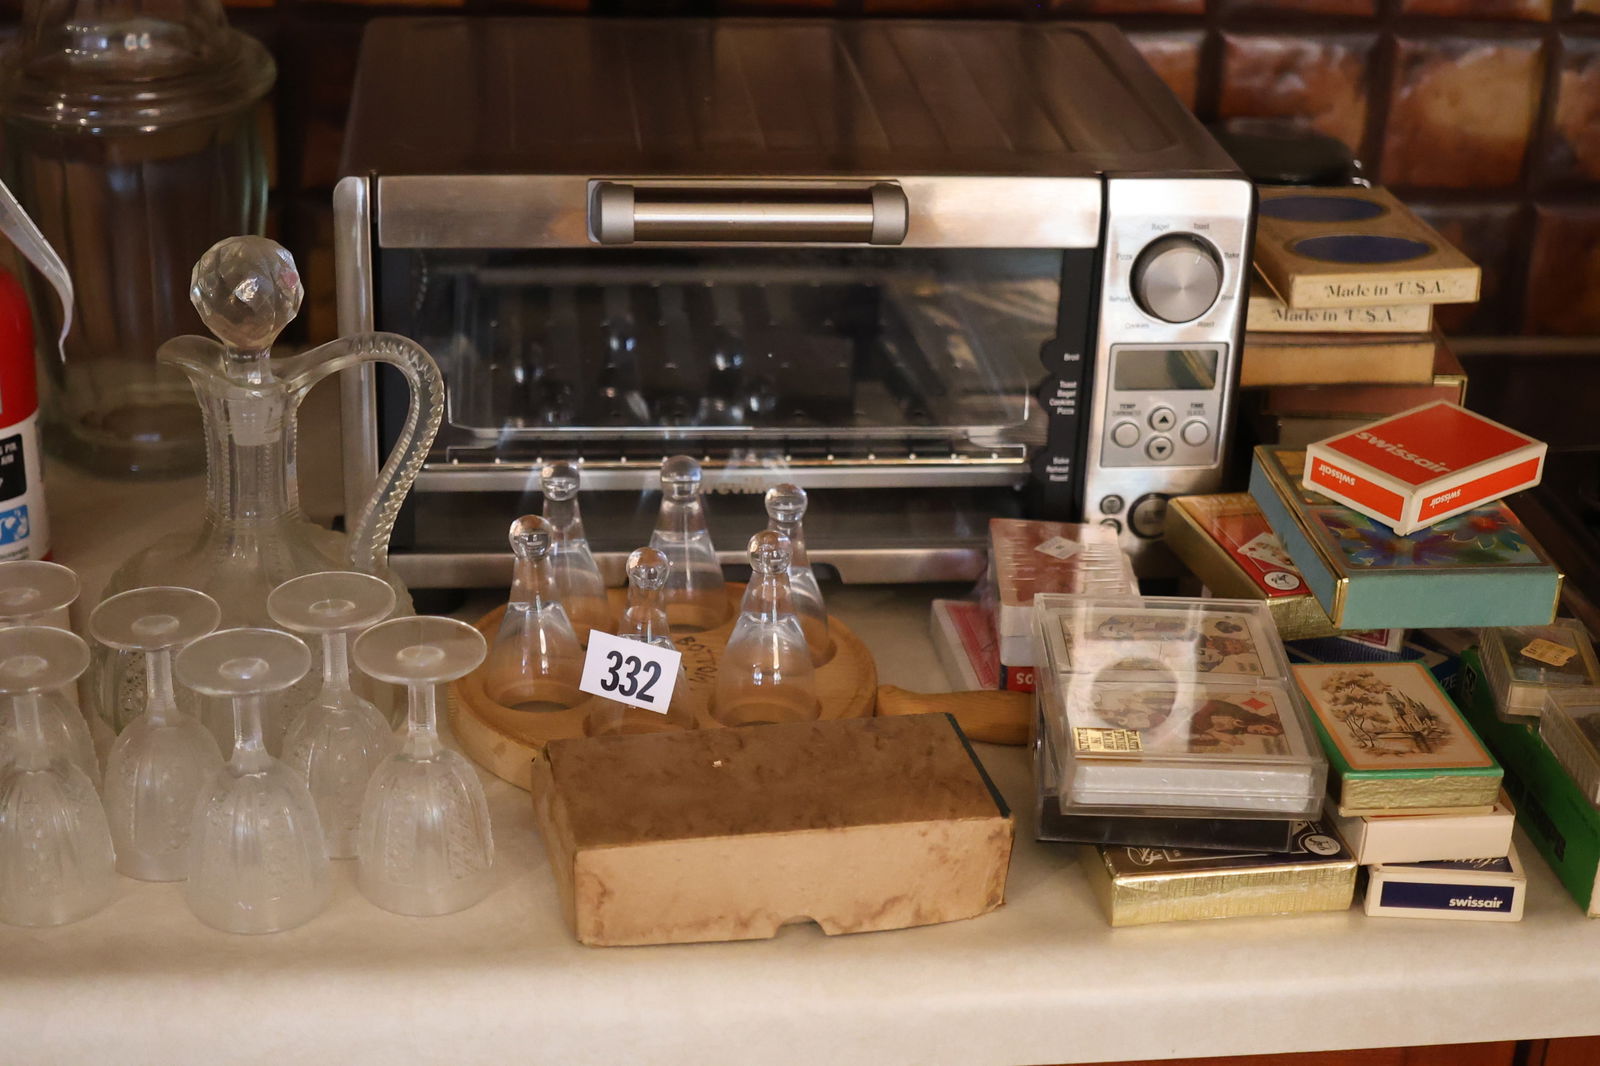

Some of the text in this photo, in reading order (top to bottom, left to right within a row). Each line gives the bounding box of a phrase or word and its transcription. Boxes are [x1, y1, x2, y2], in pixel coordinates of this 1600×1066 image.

[1325, 280, 1446, 299] Made in U.S.A.
[1272, 307, 1397, 323] Made in U.S.A.
[1355, 431, 1454, 474] swissair
[1318, 464, 1356, 486] swissair
[1429, 489, 1461, 509] swissair
[600, 650, 662, 703] 332
[1448, 895, 1503, 908] swissair
